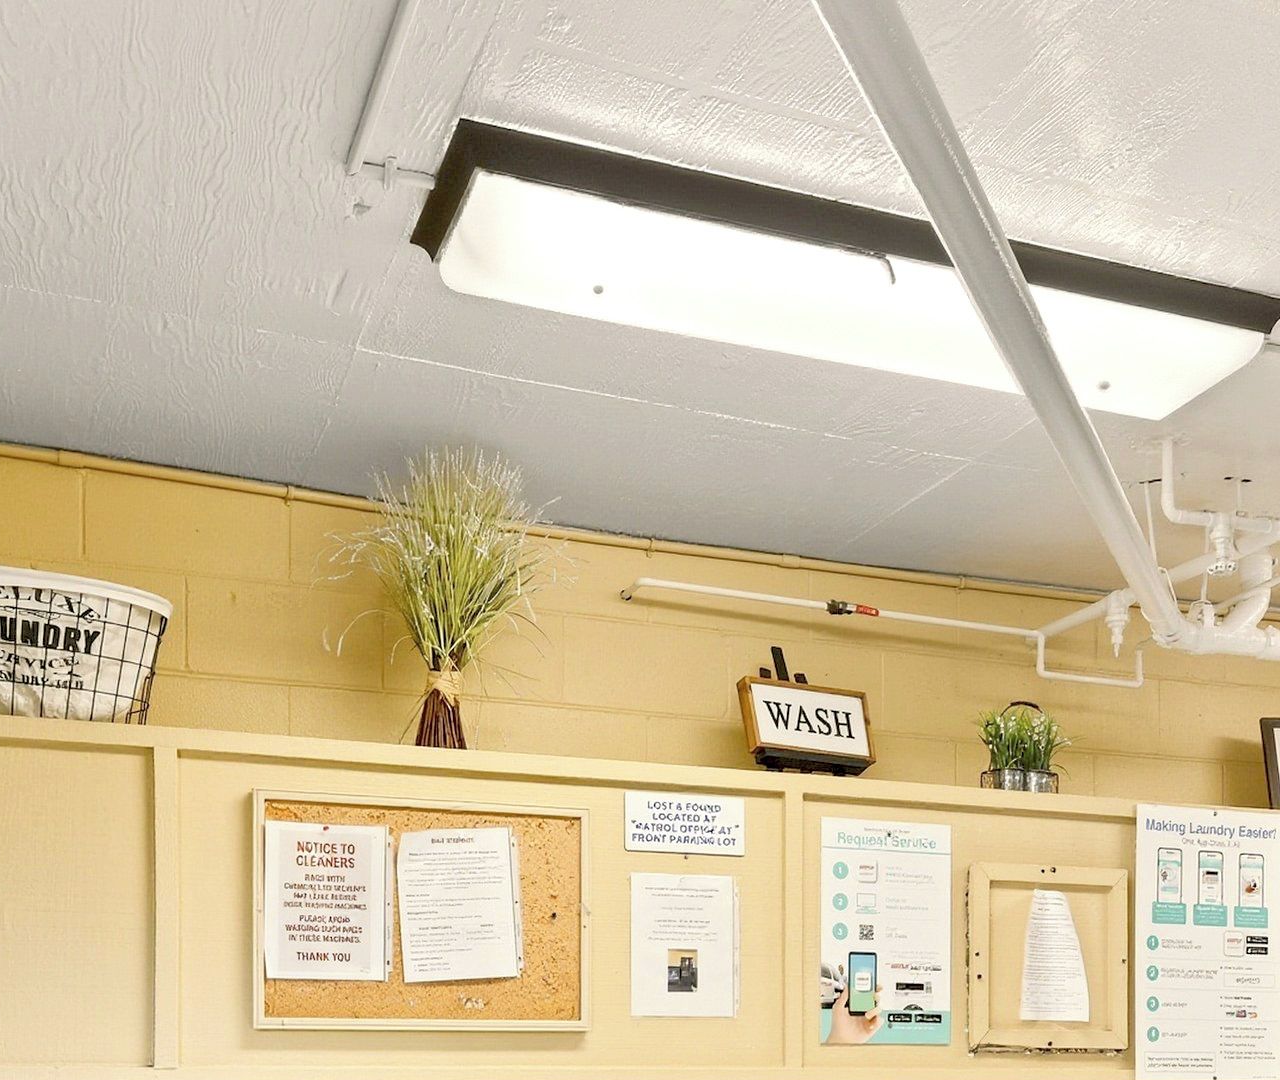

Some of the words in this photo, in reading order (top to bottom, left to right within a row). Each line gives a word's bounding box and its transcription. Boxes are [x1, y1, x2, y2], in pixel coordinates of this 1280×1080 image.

[763, 700, 855, 740] WASH
[648, 801, 673, 811] LOST
[686, 803, 721, 813] FOUND
[652, 813, 700, 823] LOCATED
[703, 815, 717, 823] AT
[1146, 818, 1186, 836] Making
[1189, 822, 1235, 839] Laundry
[632, 833, 667, 843] FRONT
[669, 835, 714, 845] PARKING
[717, 838, 736, 847] LOT
[838, 832, 887, 847] Request
[892, 836, 937, 849] Service
[297, 841, 337, 854] NOTICE
[340, 843, 355, 855] TO
[296, 855, 355, 868] CLEANERS
[297, 952, 329, 961] THANK
[332, 953, 351, 962] YOU
